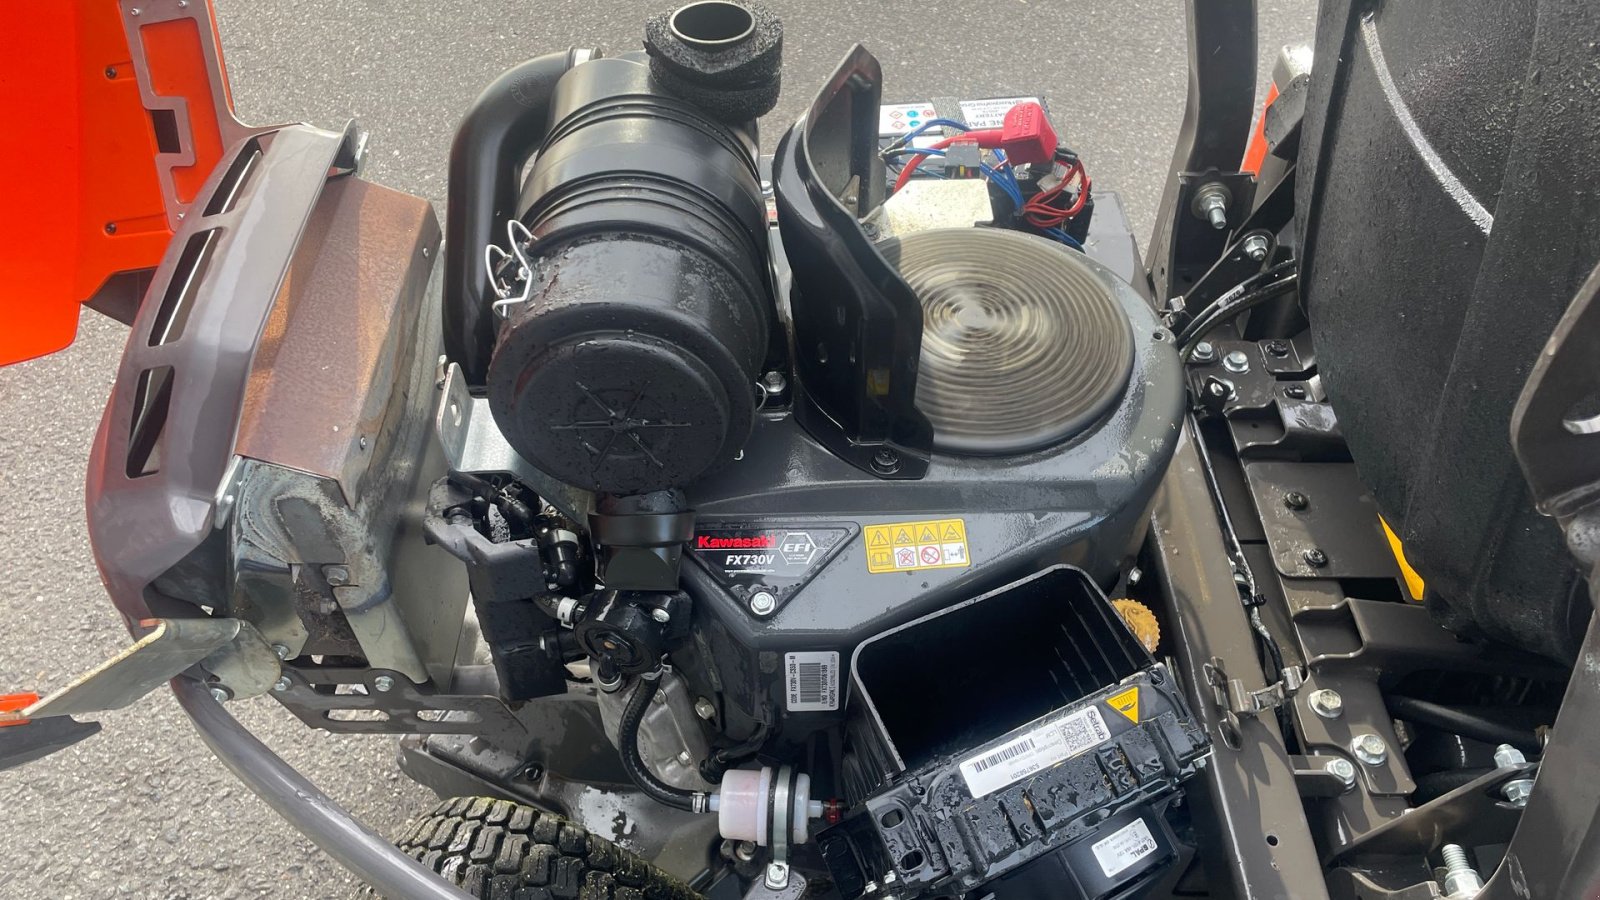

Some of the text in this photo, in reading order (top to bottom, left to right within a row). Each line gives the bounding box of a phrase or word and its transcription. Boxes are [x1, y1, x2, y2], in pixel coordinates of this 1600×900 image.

[698, 535, 776, 548] Kawasaki
[784, 543, 811, 552] EFI
[725, 554, 775, 565] FX730V
